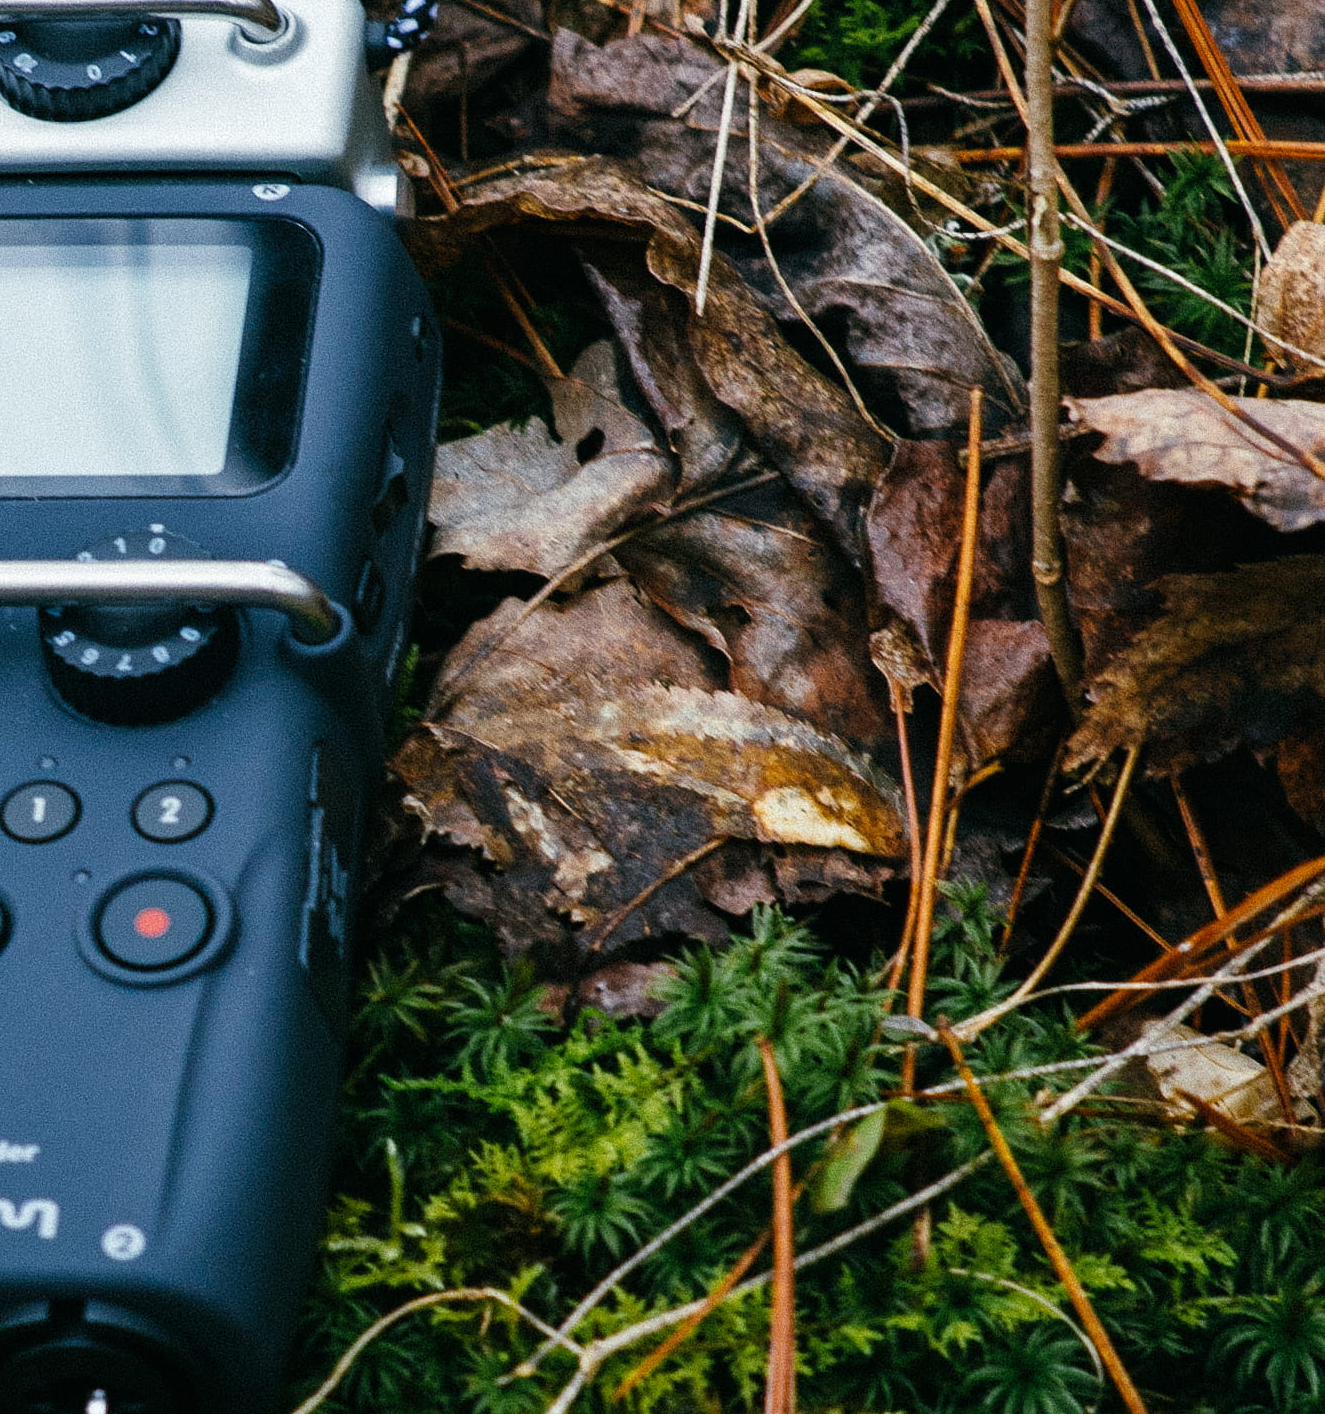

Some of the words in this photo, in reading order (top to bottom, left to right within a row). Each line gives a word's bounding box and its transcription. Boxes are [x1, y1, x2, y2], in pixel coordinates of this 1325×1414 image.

[86, 64, 102, 81] 0
[148, 537, 166, 555] 0
[32, 797, 45, 822] 1
[159, 797, 179, 822] 2
